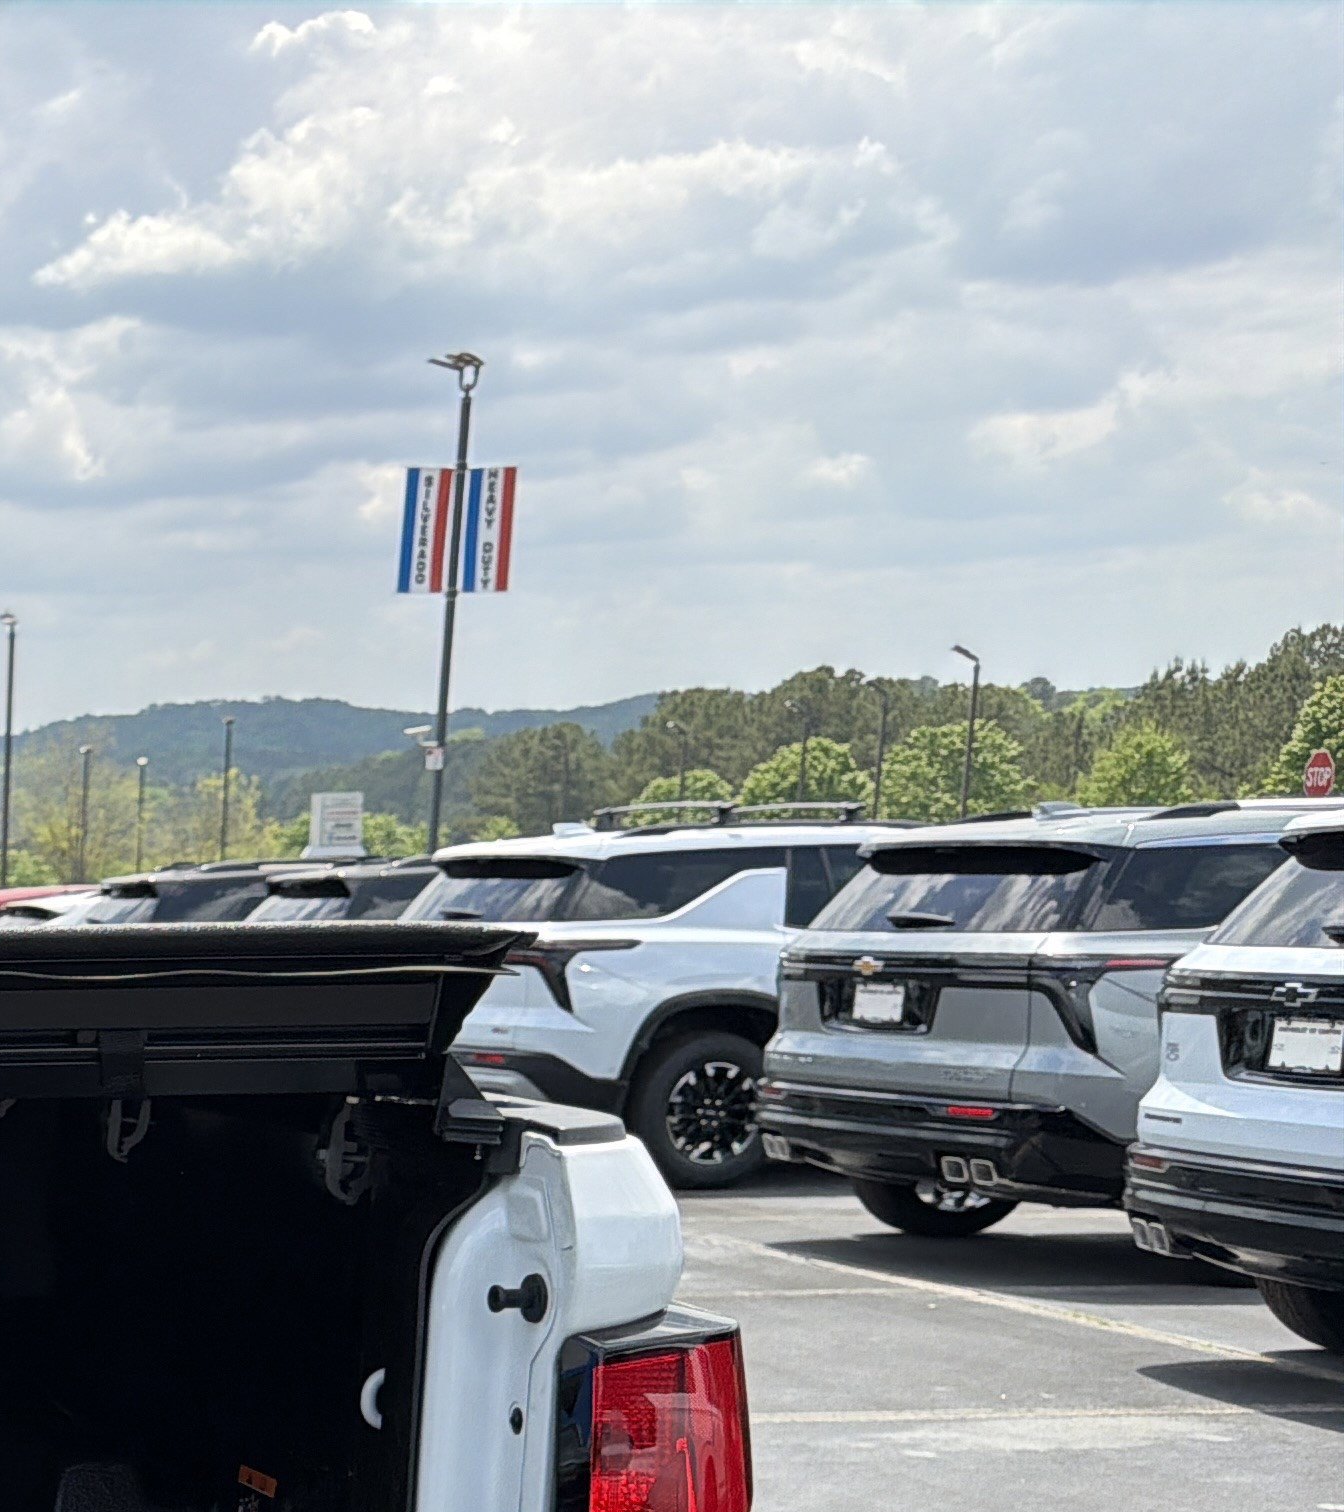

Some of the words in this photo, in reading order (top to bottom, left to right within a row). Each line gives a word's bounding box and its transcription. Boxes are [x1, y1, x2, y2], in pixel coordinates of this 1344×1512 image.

[485, 468, 499, 529] HEAVY
[415, 475, 434, 584] SILVERADO
[481, 541, 495, 589] DUTY
[1306, 766, 1332, 788] STOP
